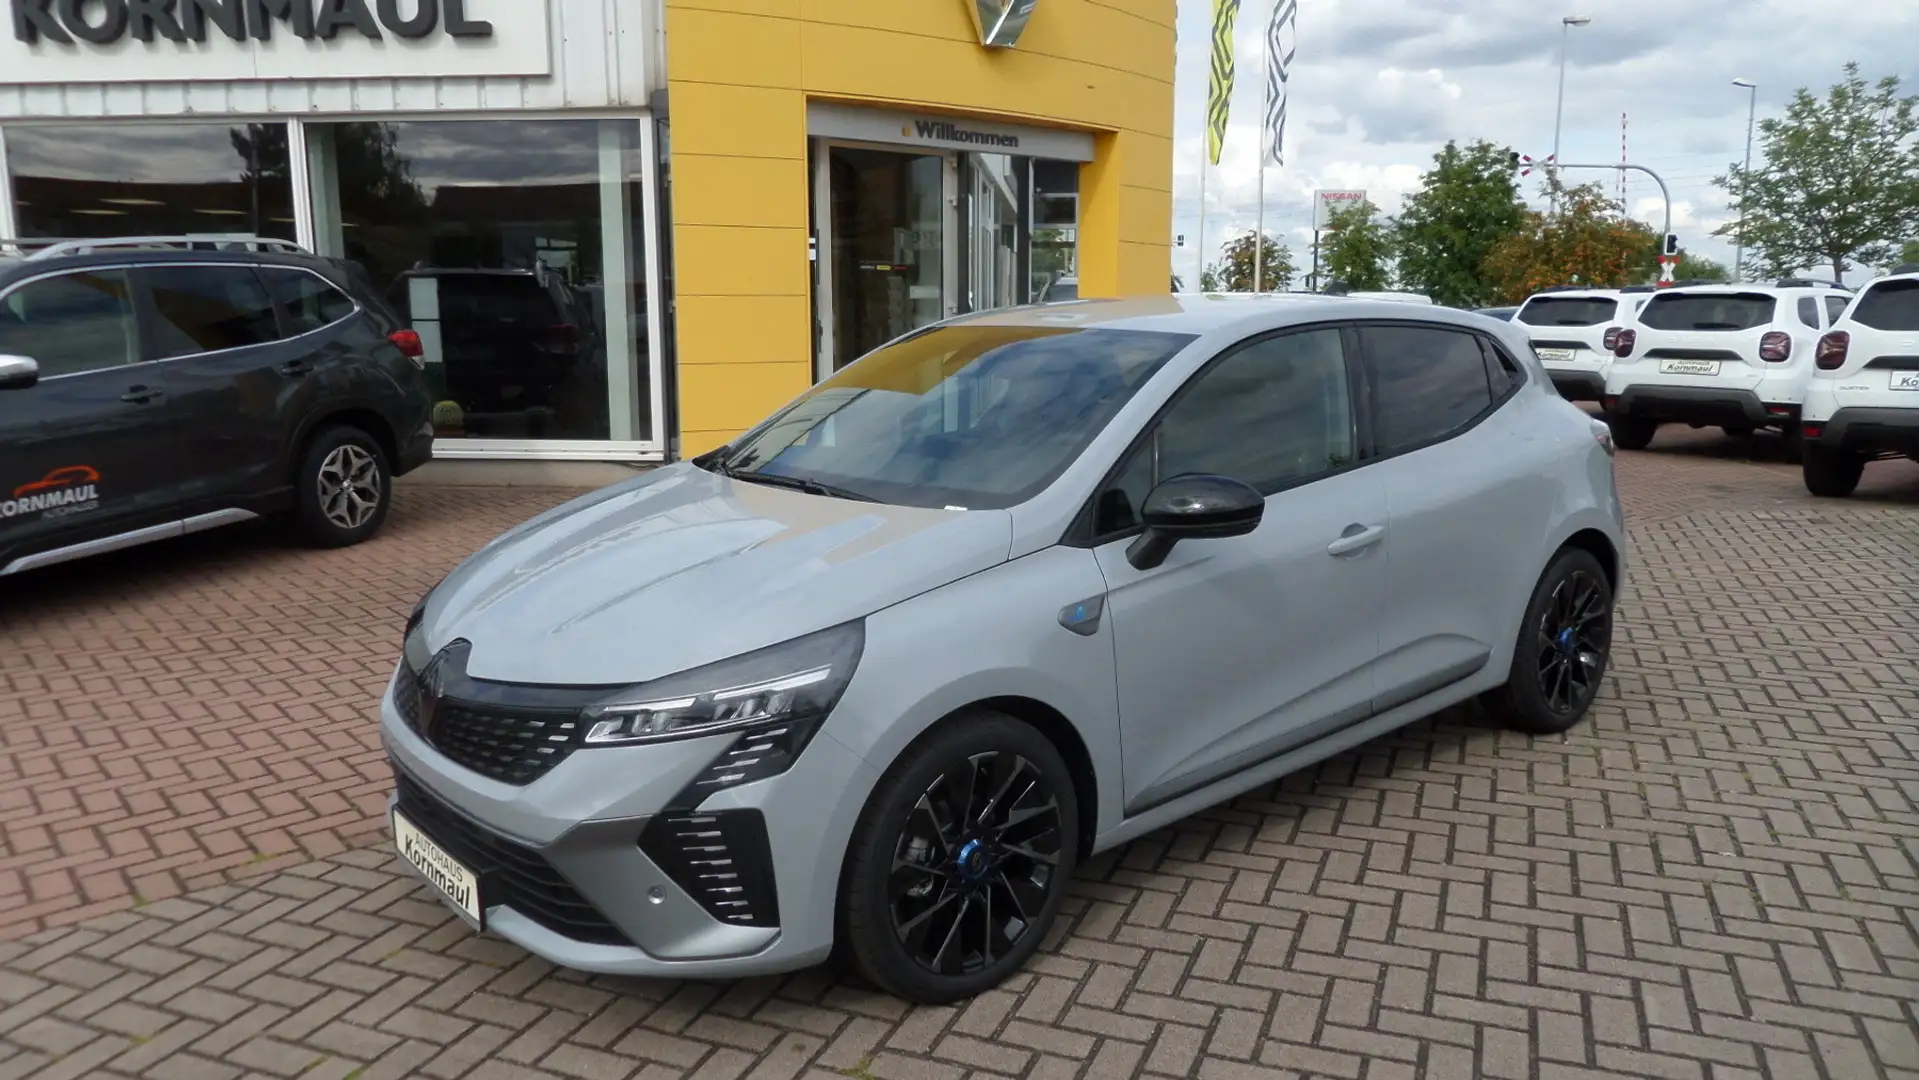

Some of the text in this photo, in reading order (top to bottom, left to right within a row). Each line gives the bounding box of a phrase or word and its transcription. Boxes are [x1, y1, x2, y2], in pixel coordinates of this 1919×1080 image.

[12, 0, 493, 44] KORNMAUL
[915, 120, 1019, 148] Willkommen
[1320, 192, 1362, 200] NISSAN
[1667, 363, 1714, 373] Kornmaul
[0, 484, 99, 518] ORNMAUL
[405, 834, 471, 910] Kornmaul
[415, 832, 463, 883] AUTOHAUS
